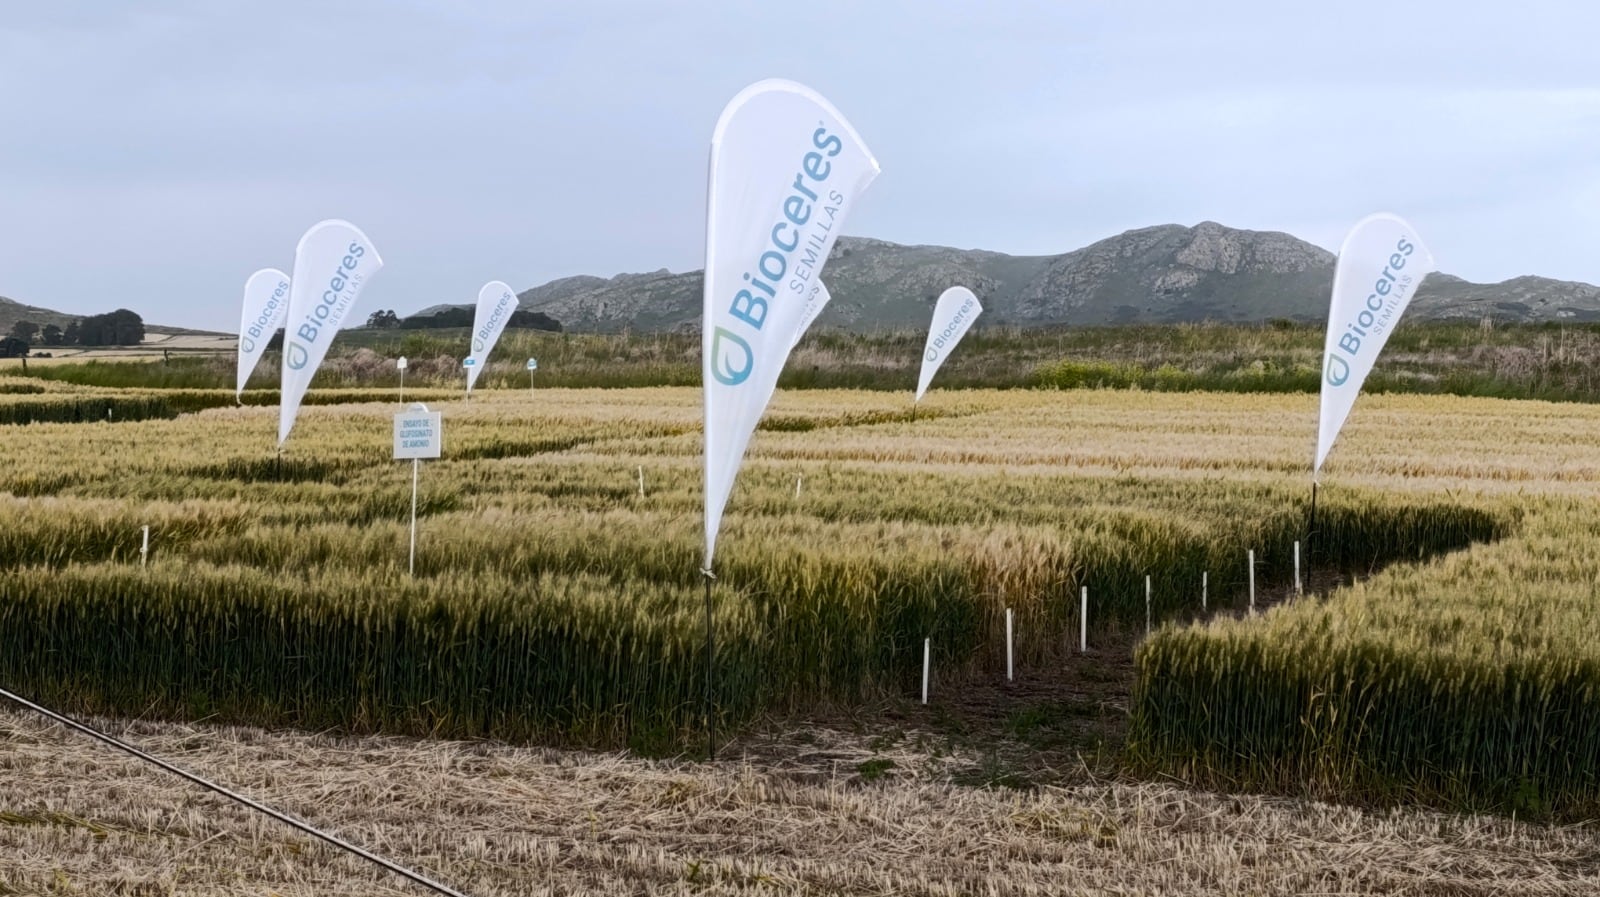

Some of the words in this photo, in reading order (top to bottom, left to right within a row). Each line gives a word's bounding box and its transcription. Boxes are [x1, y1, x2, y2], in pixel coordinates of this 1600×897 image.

[728, 127, 843, 331] Bioceres
[789, 189, 844, 295] SEMILLAS
[248, 280, 289, 339] Bioceres
[297, 241, 365, 343] Bioceres
[328, 273, 363, 327] SEMILLAS
[479, 291, 511, 340] Bioceres
[1338, 238, 1415, 356] Bioceres
[1373, 274, 1413, 336] SEMILLAS
[933, 298, 974, 349] Bioceres
[422, 419, 430, 427] DE
